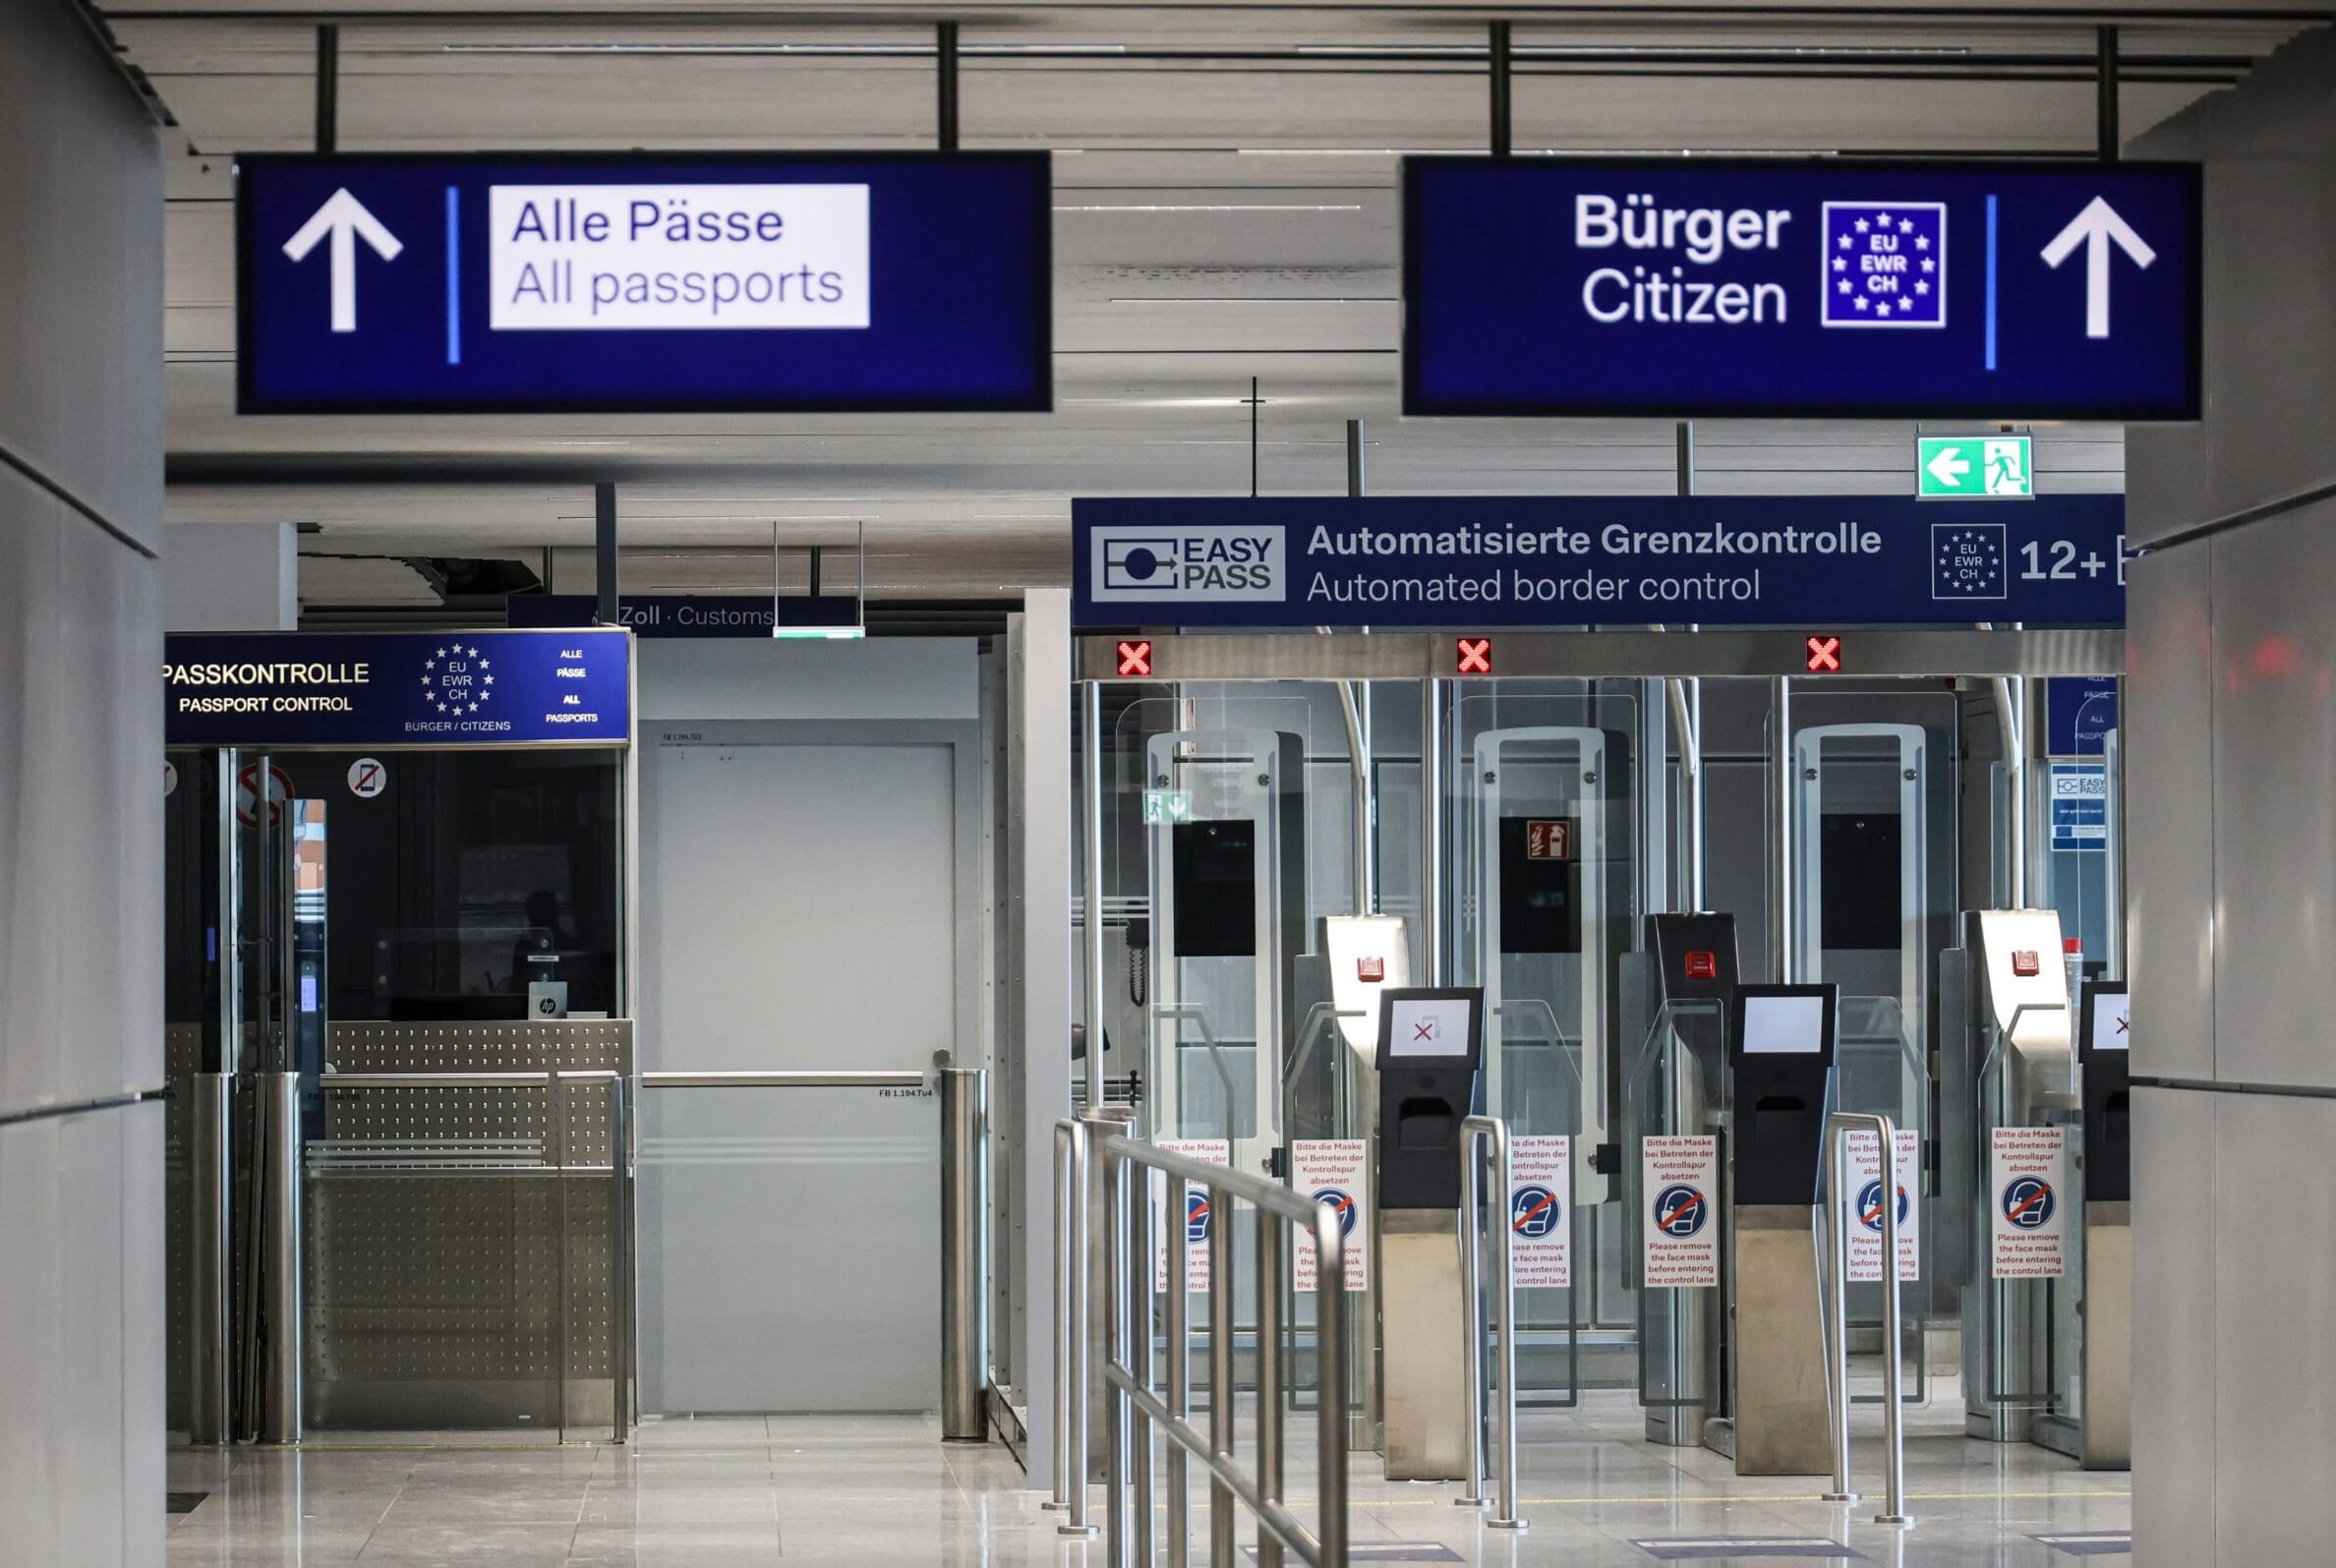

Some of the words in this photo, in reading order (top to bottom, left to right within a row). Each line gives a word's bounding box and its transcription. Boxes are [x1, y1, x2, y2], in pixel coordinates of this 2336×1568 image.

[511, 199, 612, 243] Alle
[629, 199, 785, 243] Pässe
[1575, 195, 1790, 263] Bürger
[1870, 235, 1898, 252] EU
[1861, 255, 1907, 272] EWR
[511, 261, 572, 305] All
[591, 264, 843, 316] passports
[1867, 274, 1898, 294] CH
[1582, 267, 1786, 323] Citizen
[1308, 524, 1591, 554] Automatisierte
[1602, 522, 1882, 554] Grenzkontrolle
[1185, 538, 1272, 562] EASY
[1960, 544, 1977, 555] EU
[1955, 555, 1983, 568] EWR
[2020, 541, 2106, 580] 12+
[1184, 565, 1271, 590] PASS
[1959, 569, 1978, 580] CH
[1307, 570, 1500, 602] Automated
[1514, 570, 1630, 602] border
[1639, 569, 1760, 601] control
[619, 606, 661, 625] Zoll
[677, 607, 775, 625] Customs
[560, 650, 583, 659] ALLE
[448, 662, 467, 672] EU
[556, 667, 586, 677] PÄSSE
[442, 674, 473, 686] EWR
[448, 689, 467, 700] CH
[563, 695, 580, 704] ALL
[180, 697, 267, 713] PASSPORT
[272, 696, 353, 712] CONTROL
[546, 713, 598, 723] PASSPORTS
[404, 721, 452, 731] BÜRGER
[460, 721, 511, 731] CITIZENS
[2002, 1152, 2054, 1162] Kontrollspur
[1303, 1165, 1356, 1175] Kontrollspur
[1512, 1161, 1558, 1170] ontrollspur
[1653, 1161, 1706, 1170] Kontrollspur
